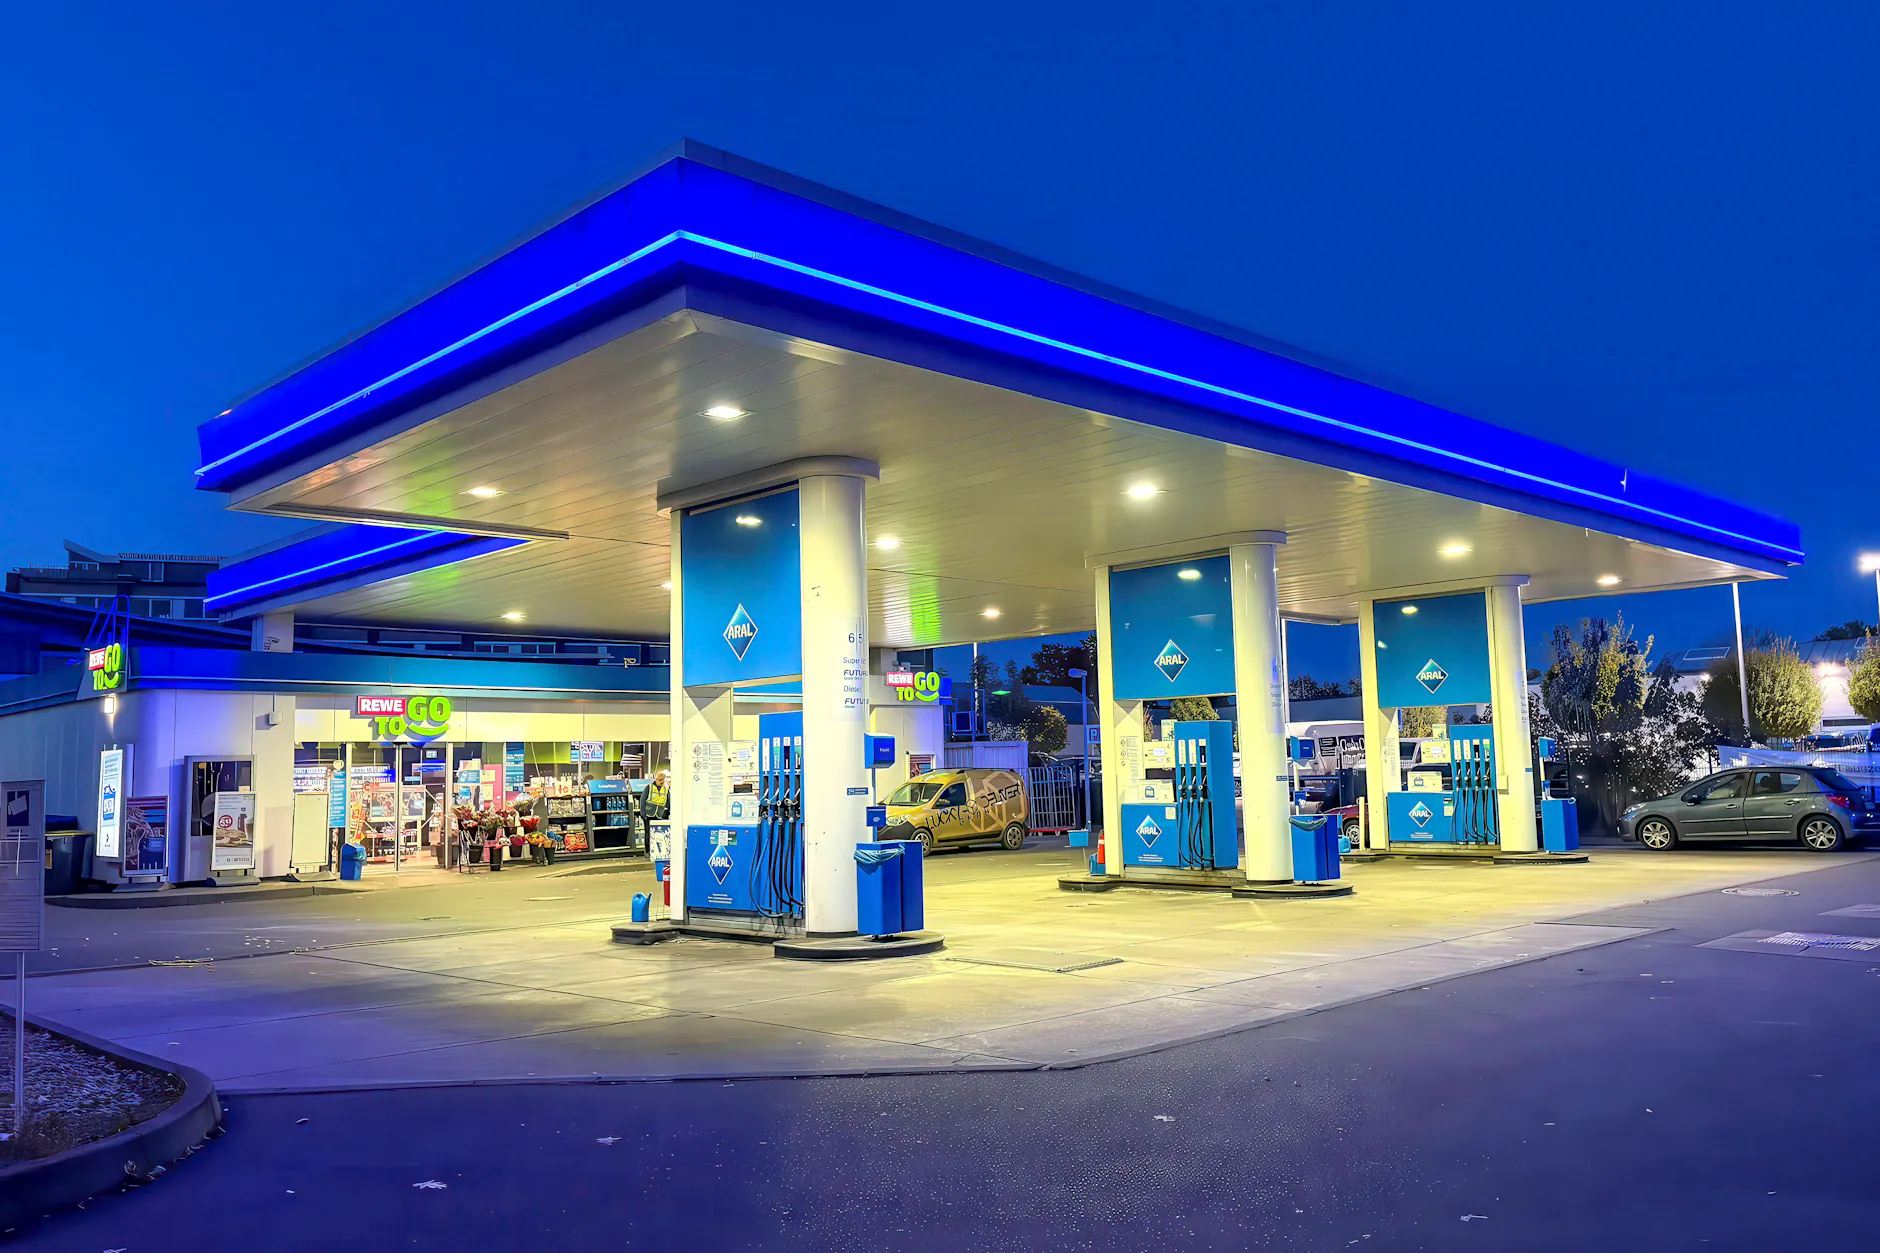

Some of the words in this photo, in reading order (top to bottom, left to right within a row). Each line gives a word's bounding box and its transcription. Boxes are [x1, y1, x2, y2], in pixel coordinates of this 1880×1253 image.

[728, 623, 753, 640] ARAL
[104, 643, 120, 673] GO
[1159, 654, 1184, 666] ARAL
[1420, 670, 1444, 680] ARAL
[896, 687, 915, 701] TO
[914, 671, 940, 691] GO
[360, 699, 403, 712] REWE
[375, 716, 406, 736] TO
[407, 697, 451, 722] GO
[1411, 810, 1430, 818] ARAL
[1139, 826, 1159, 835] ARAL
[711, 856, 730, 868] ARAL
